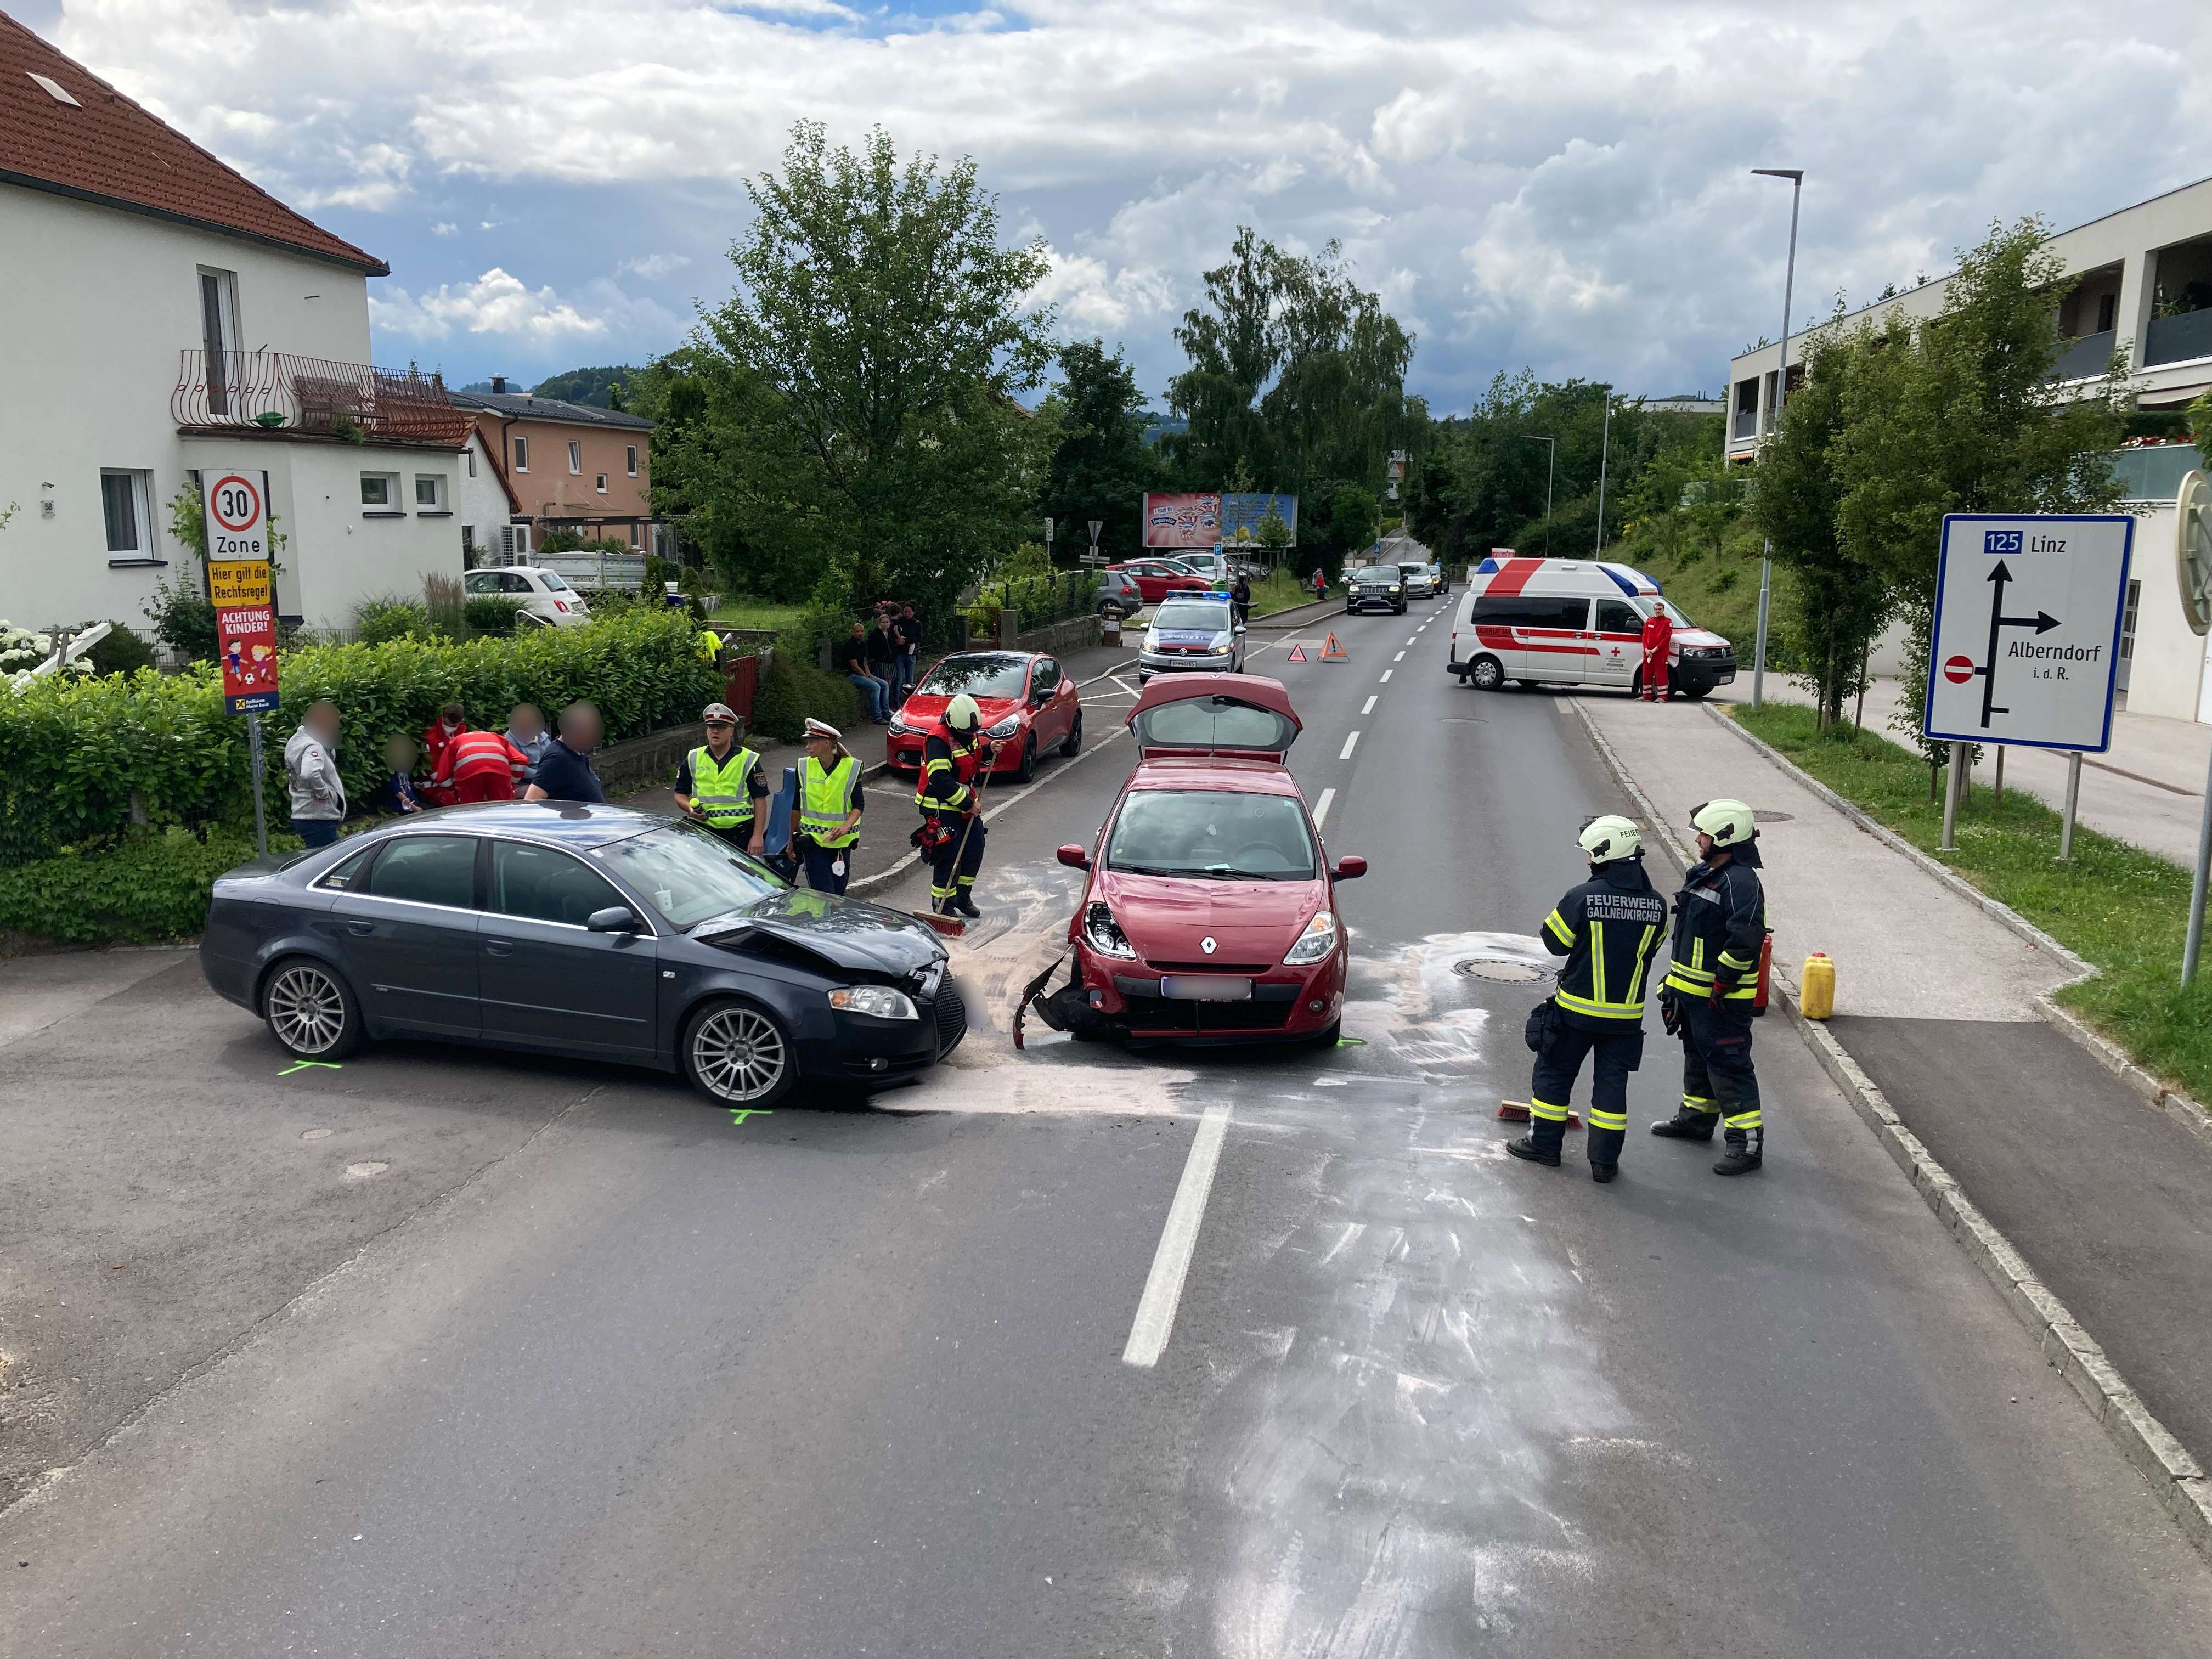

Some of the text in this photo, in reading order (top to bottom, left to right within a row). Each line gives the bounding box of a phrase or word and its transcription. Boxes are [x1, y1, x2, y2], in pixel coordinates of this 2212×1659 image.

[222, 490, 247, 517] 30
[216, 536, 259, 553] Zone
[1216, 545, 1221, 554] P
[1987, 534, 2067, 552] 125 Linz
[212, 566, 267, 583] Hier gilt die
[215, 584, 268, 600] Rechtsregel
[222, 610, 270, 624] ACHTUNG
[225, 621, 268, 635] KINDER!
[2008, 641, 2102, 662] Alberndorf
[2033, 667, 2069, 680] i. d. R.
